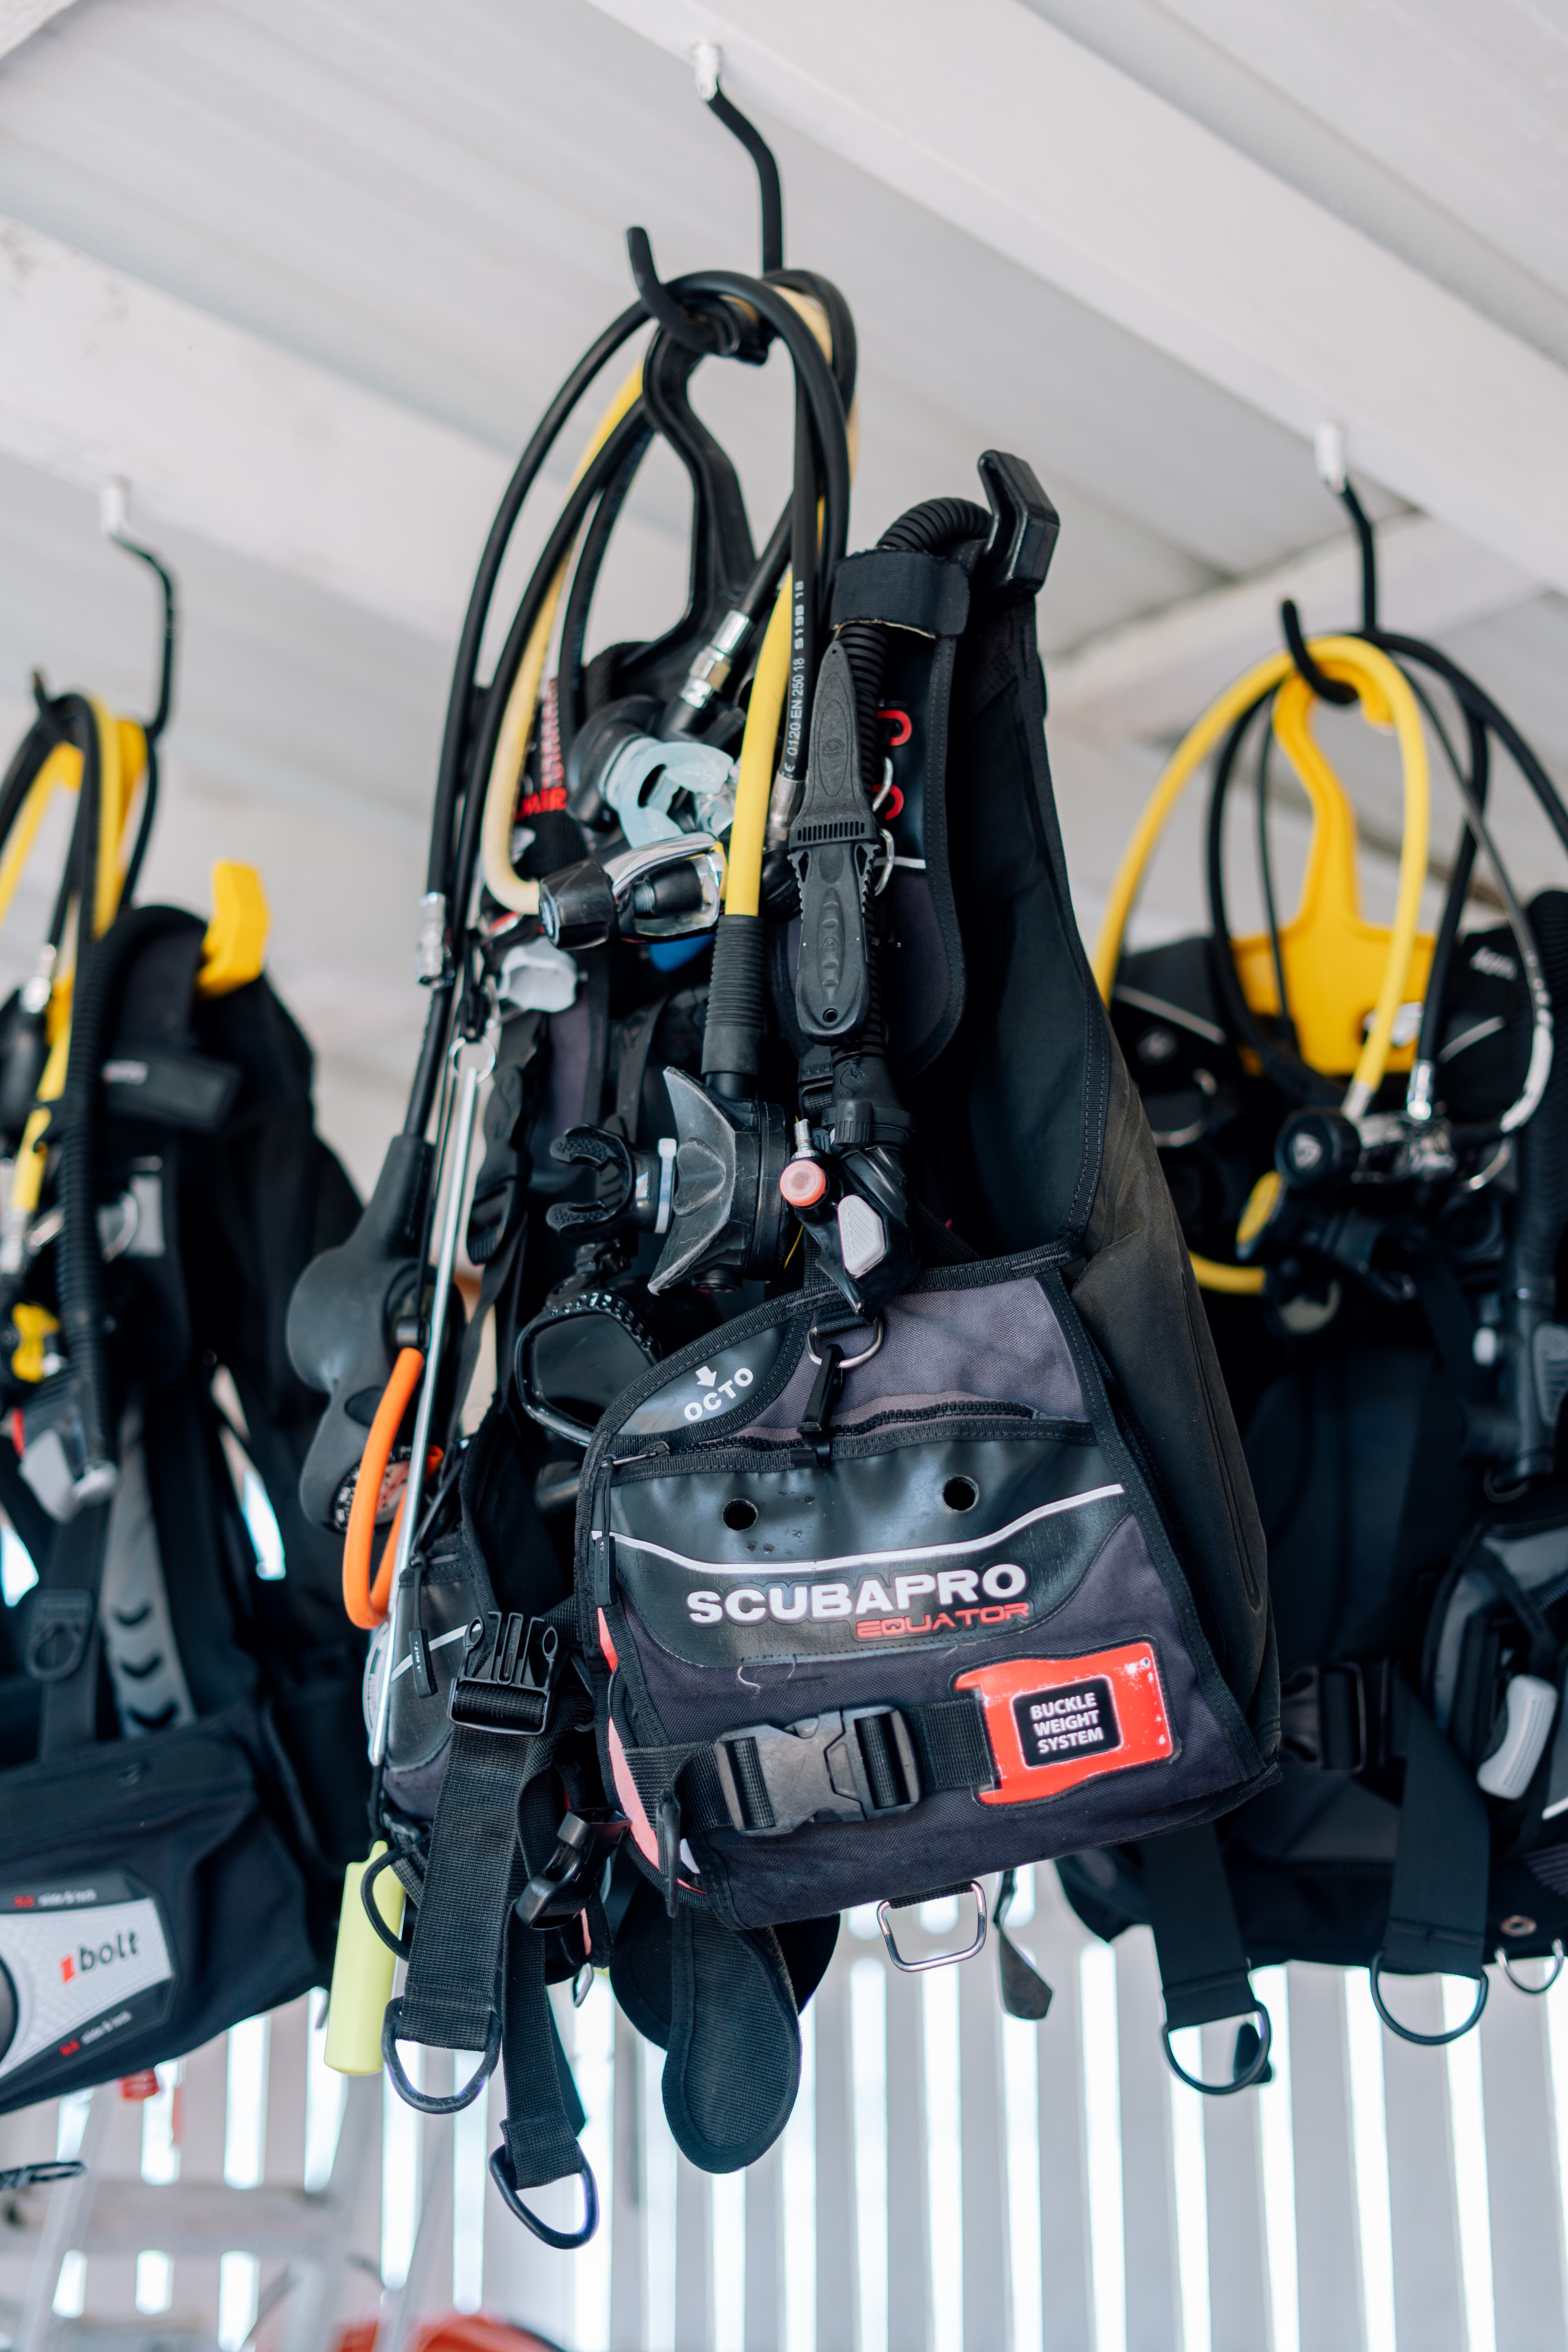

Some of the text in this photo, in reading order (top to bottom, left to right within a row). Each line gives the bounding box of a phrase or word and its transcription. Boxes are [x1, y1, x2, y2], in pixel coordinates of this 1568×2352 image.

[793, 658, 805, 671] 18
[791, 675, 804, 696] 250
[790, 700, 802, 719] EN
[787, 722, 801, 756] 0120
[684, 1368, 753, 1421] OCTO
[687, 1564, 1027, 1623] SCUBAPRO
[856, 1602, 1030, 1638] EQUATOR
[1030, 1692, 1097, 1720] BUCKLE
[1033, 1709, 1099, 1736] WEIGHT
[1038, 1727, 1104, 1753] SYSTEM
[80, 1931, 137, 1971] bolt
